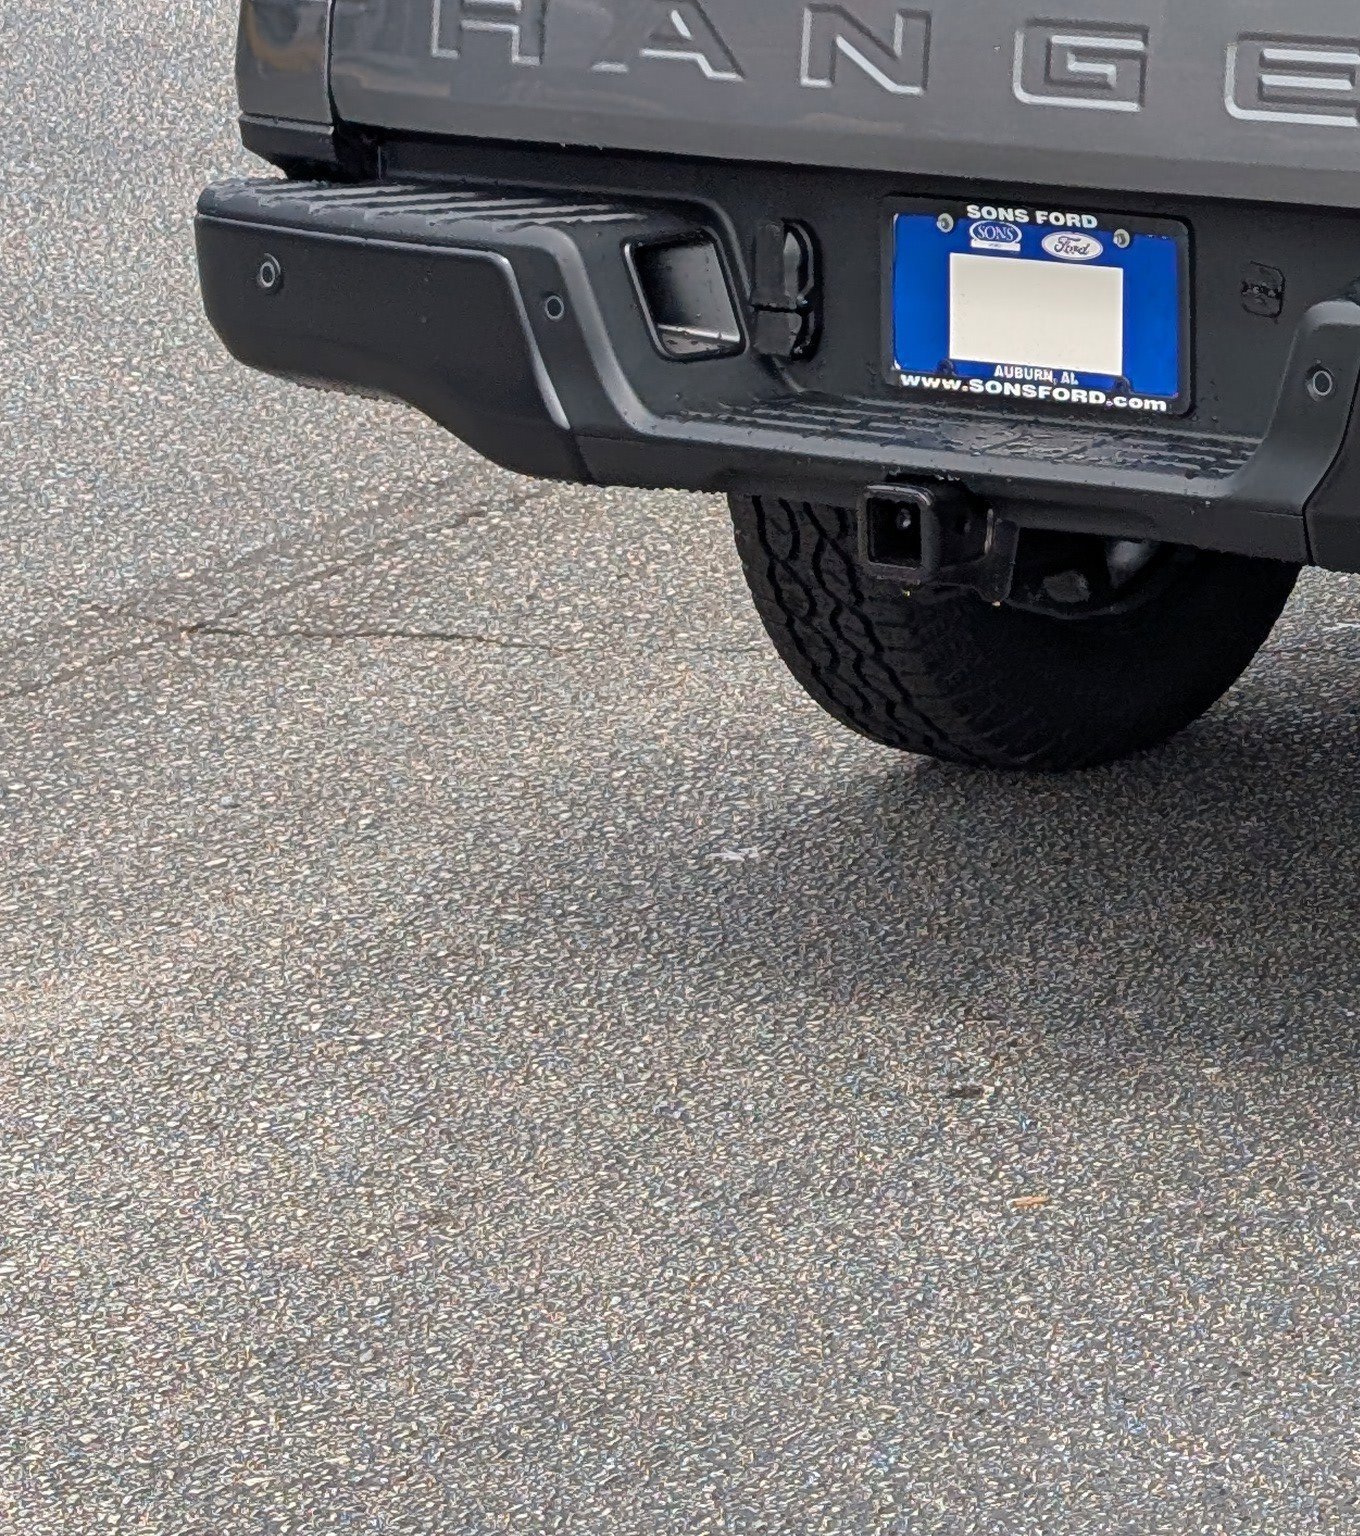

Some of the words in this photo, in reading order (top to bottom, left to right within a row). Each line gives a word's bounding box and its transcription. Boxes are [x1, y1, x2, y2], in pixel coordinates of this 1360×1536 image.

[966, 204, 1029, 223] SONS
[1036, 210, 1098, 229] FORD
[977, 224, 1014, 241] SONS
[1053, 235, 1091, 255] Ford
[1060, 372, 1079, 385] AL
[900, 373, 1167, 412] www.SONSFORD.com
